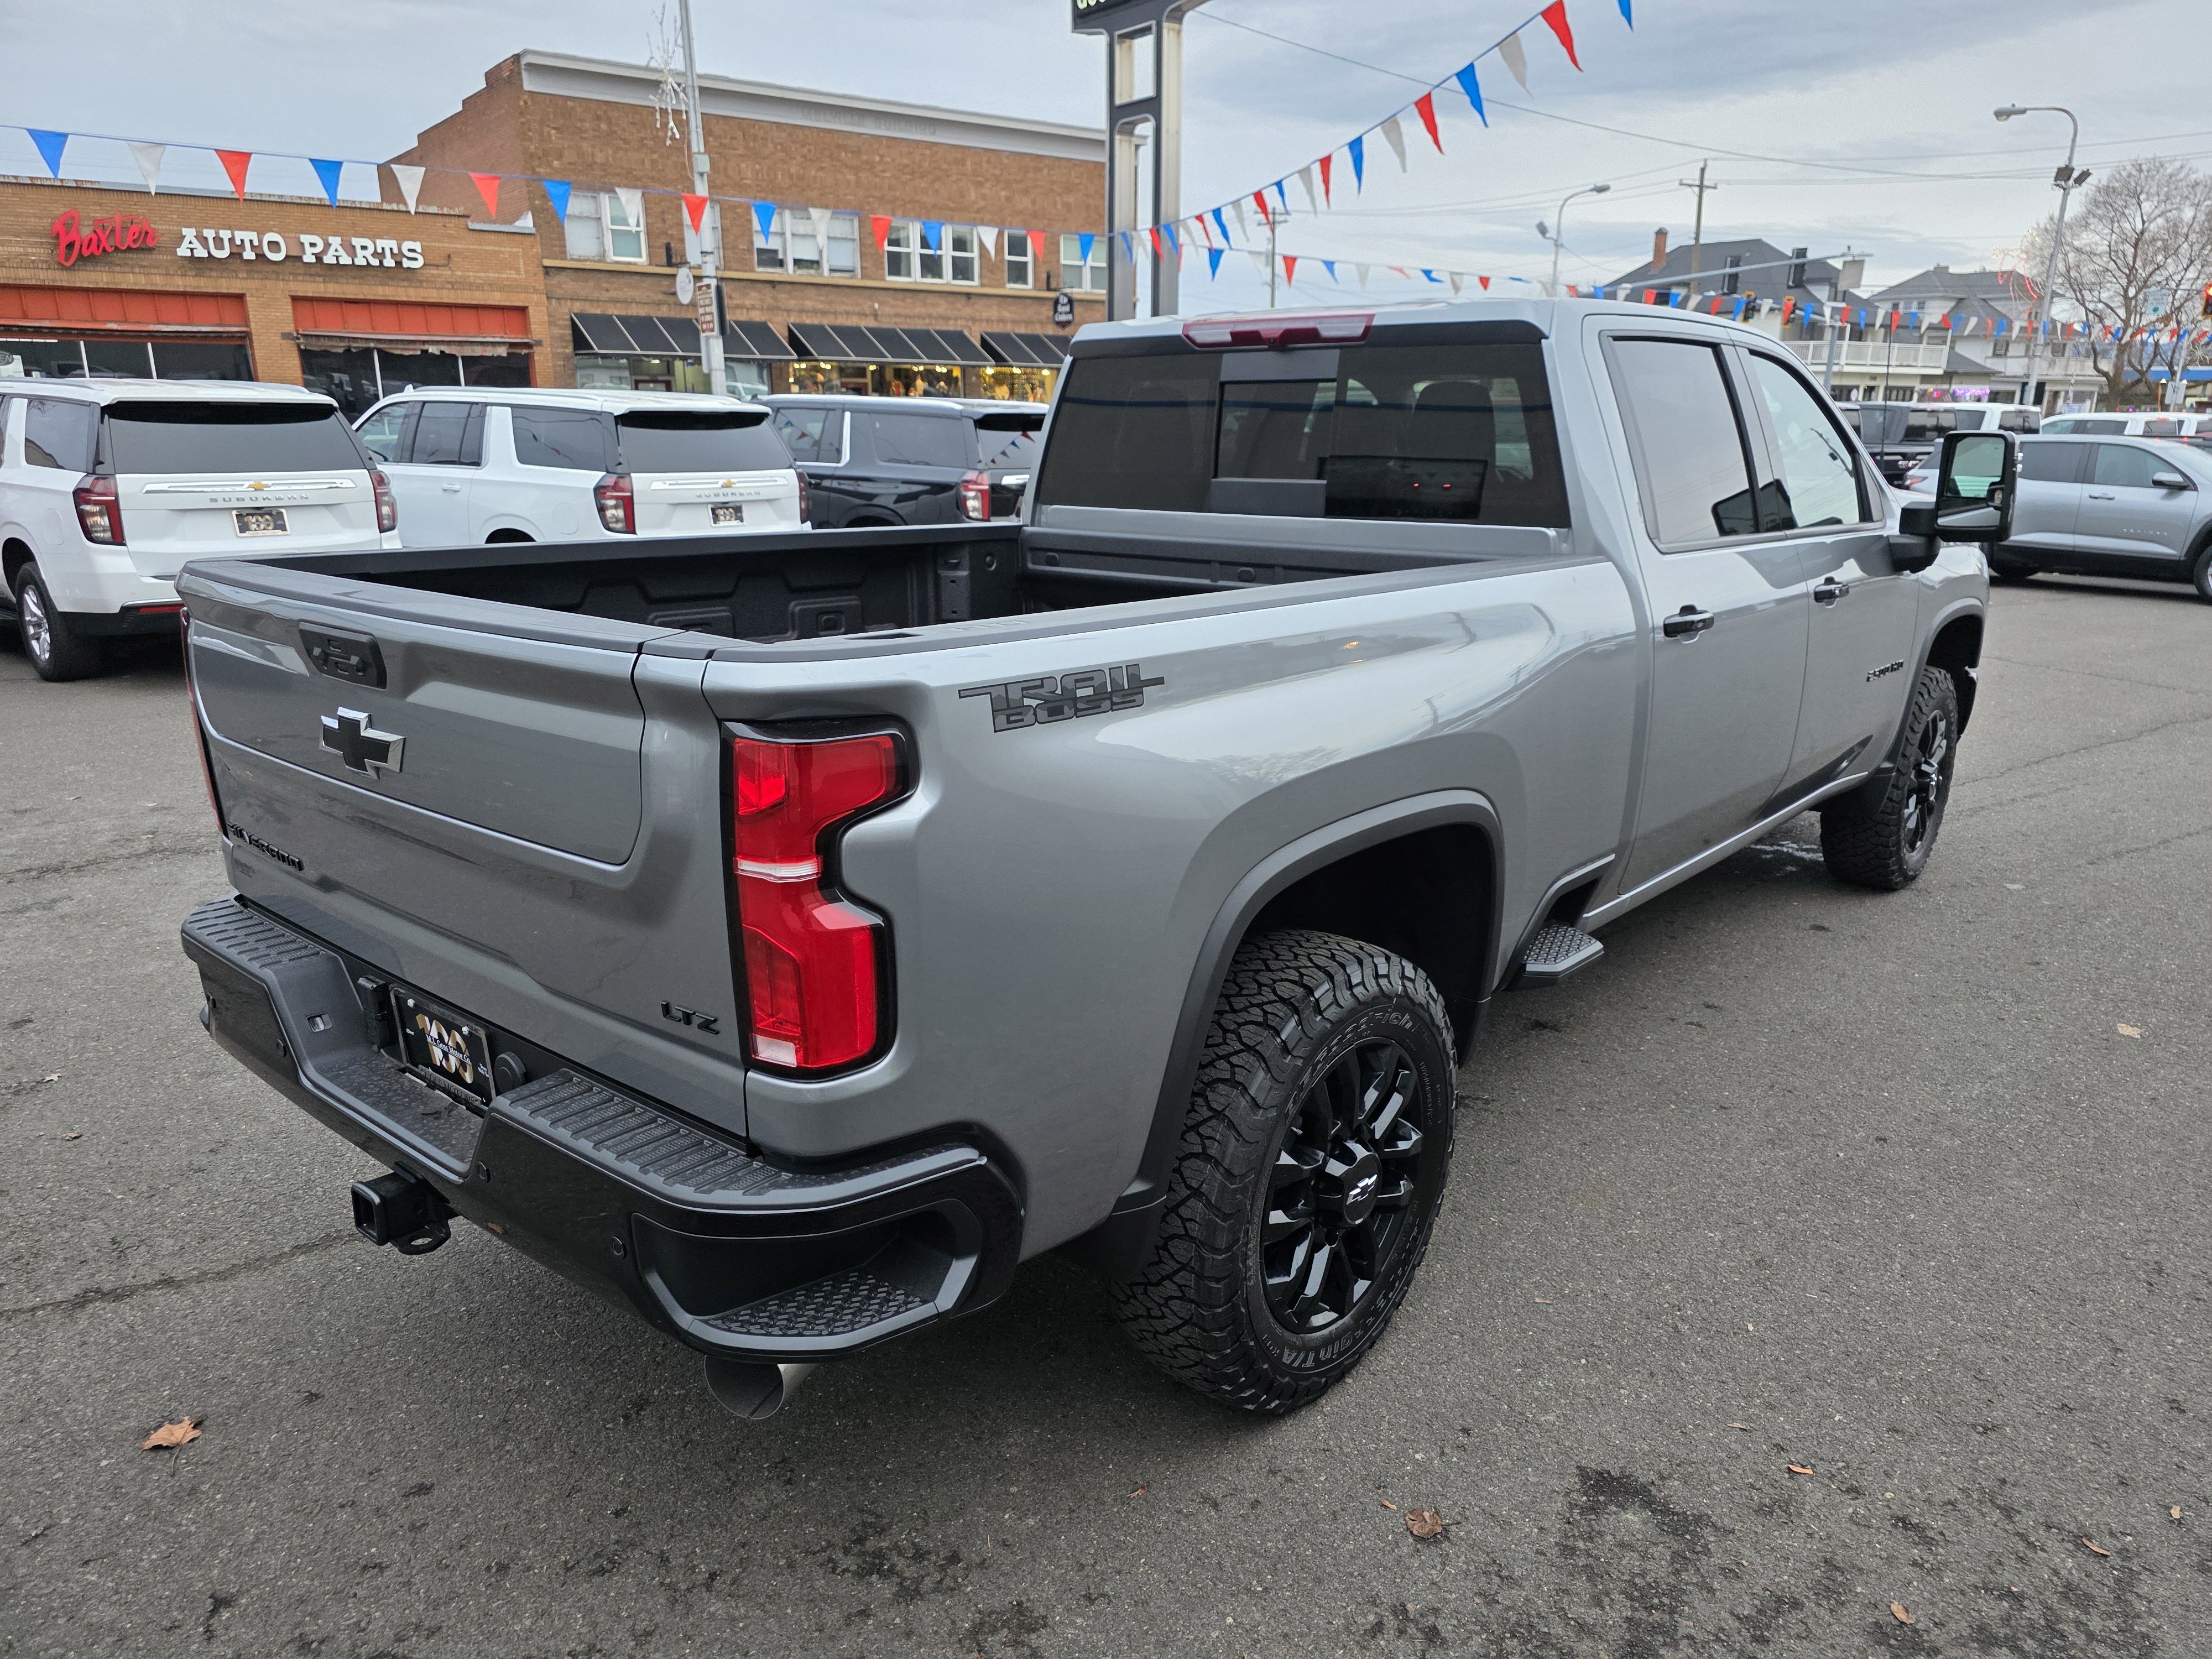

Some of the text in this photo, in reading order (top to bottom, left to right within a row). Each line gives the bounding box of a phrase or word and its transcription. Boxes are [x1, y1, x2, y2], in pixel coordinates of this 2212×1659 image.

[51, 209, 425, 269] Baxter AUTO PARTS
[958, 663, 1165, 711] TRAIL
[993, 690, 1145, 733] BOSS
[660, 999, 721, 1035] LTZ
[416, 1013, 474, 1084] 100
